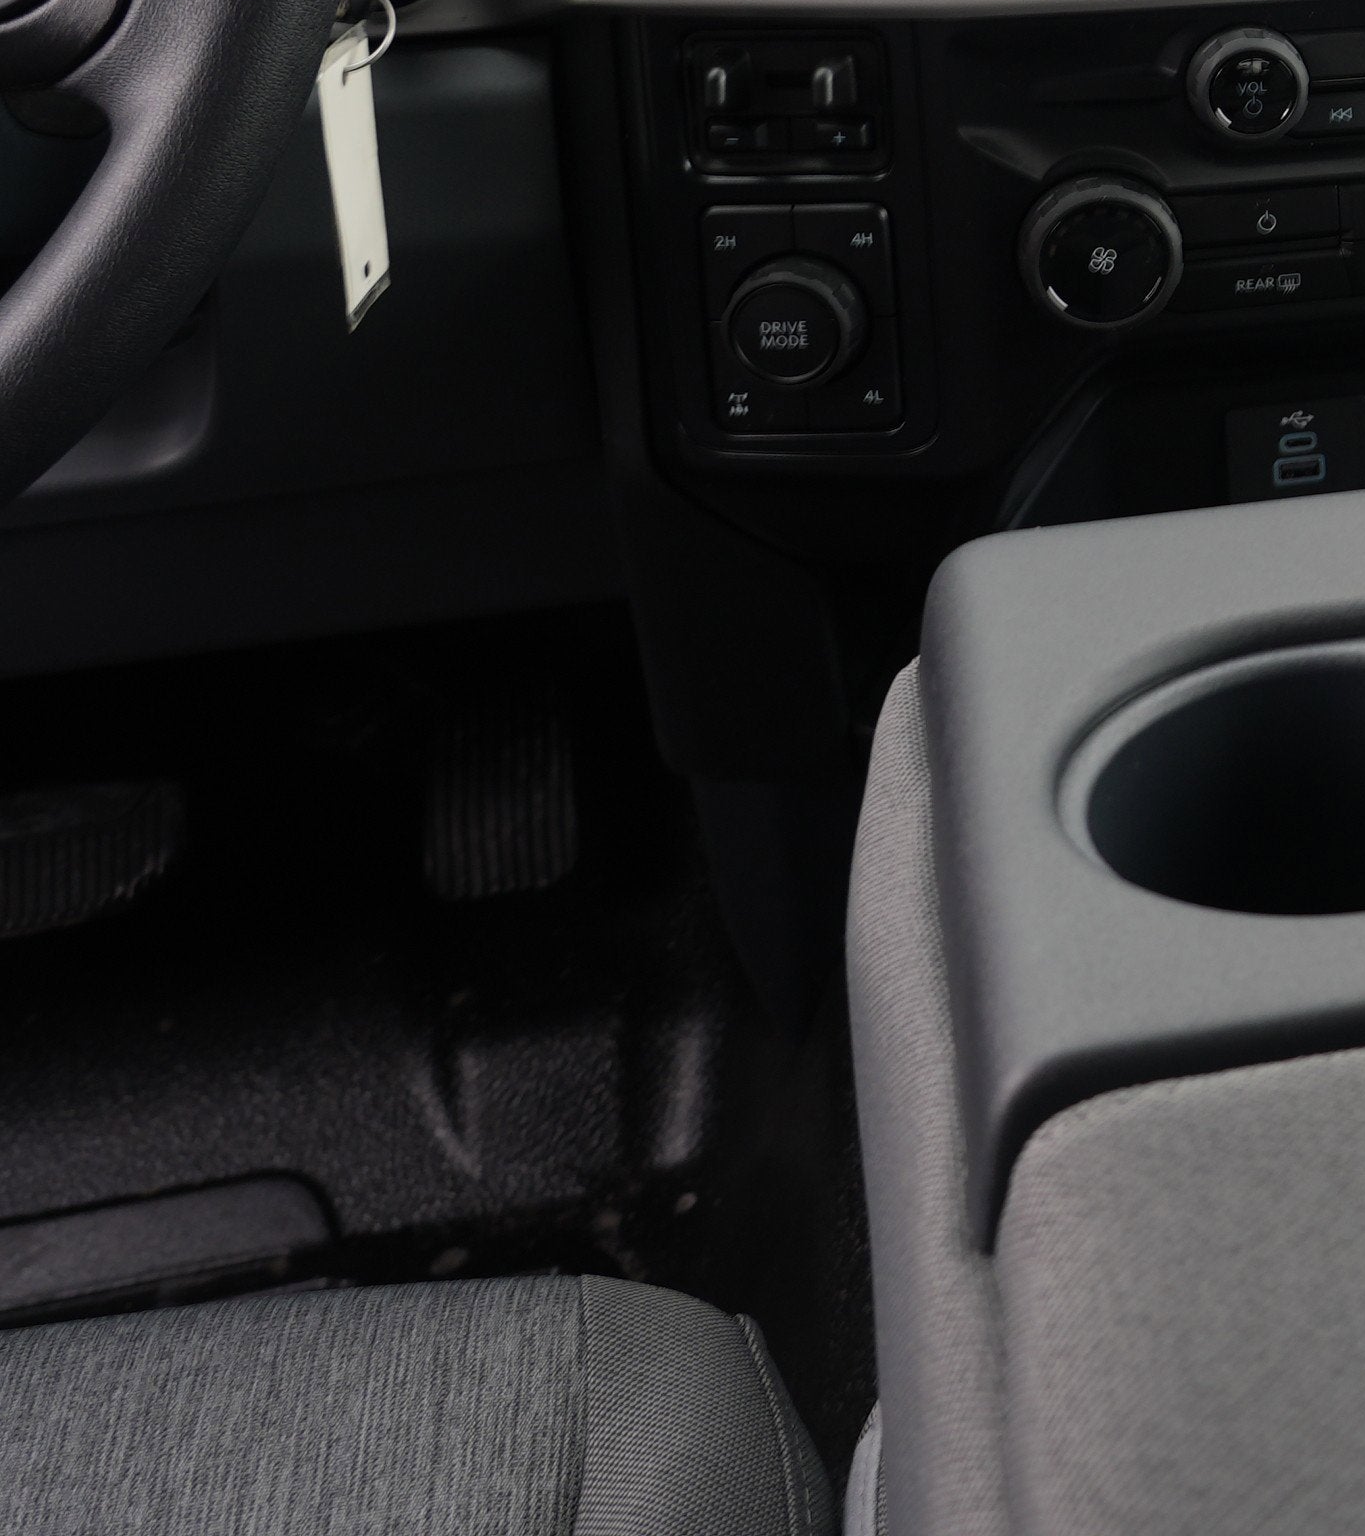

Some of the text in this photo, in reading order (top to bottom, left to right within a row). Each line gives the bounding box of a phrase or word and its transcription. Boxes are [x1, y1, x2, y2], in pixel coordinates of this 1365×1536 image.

[1237, 81, 1268, 96] VOL
[714, 234, 737, 251] 2H
[851, 231, 873, 248] 4H
[1235, 276, 1275, 293] REAR
[760, 320, 808, 335] DRIVE
[760, 334, 809, 350] MODE
[863, 389, 883, 405] 4L
